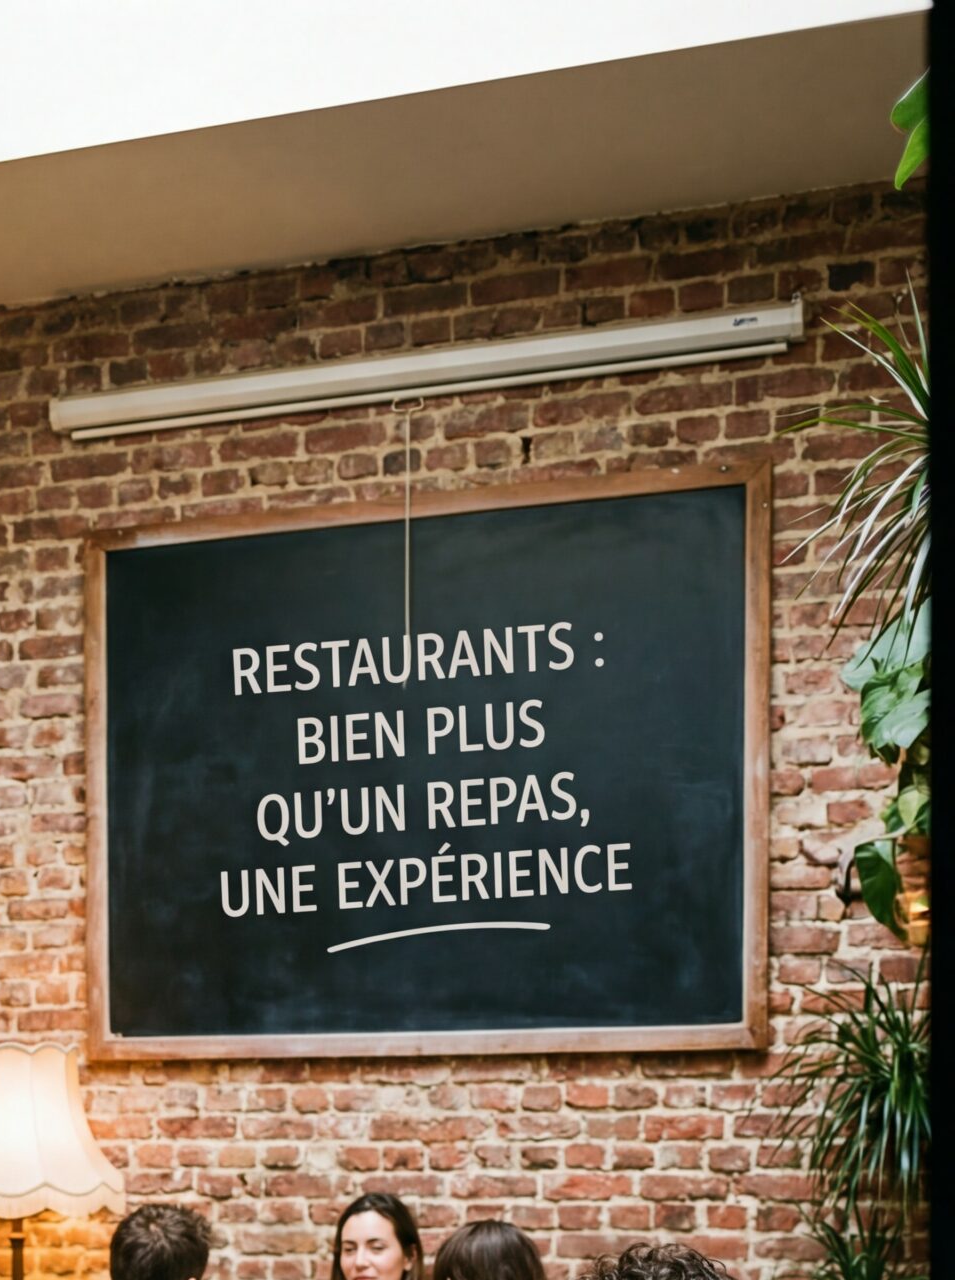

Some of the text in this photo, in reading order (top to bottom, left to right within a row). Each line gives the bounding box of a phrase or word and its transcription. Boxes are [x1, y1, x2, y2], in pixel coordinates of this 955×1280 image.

[232, 621, 575, 696] RESTAURANTS
[297, 699, 546, 765] BIEN PLUS
[256, 771, 590, 847] QU'UN REPAS,
[220, 842, 633, 918] UNE EXPÉRIENCE
